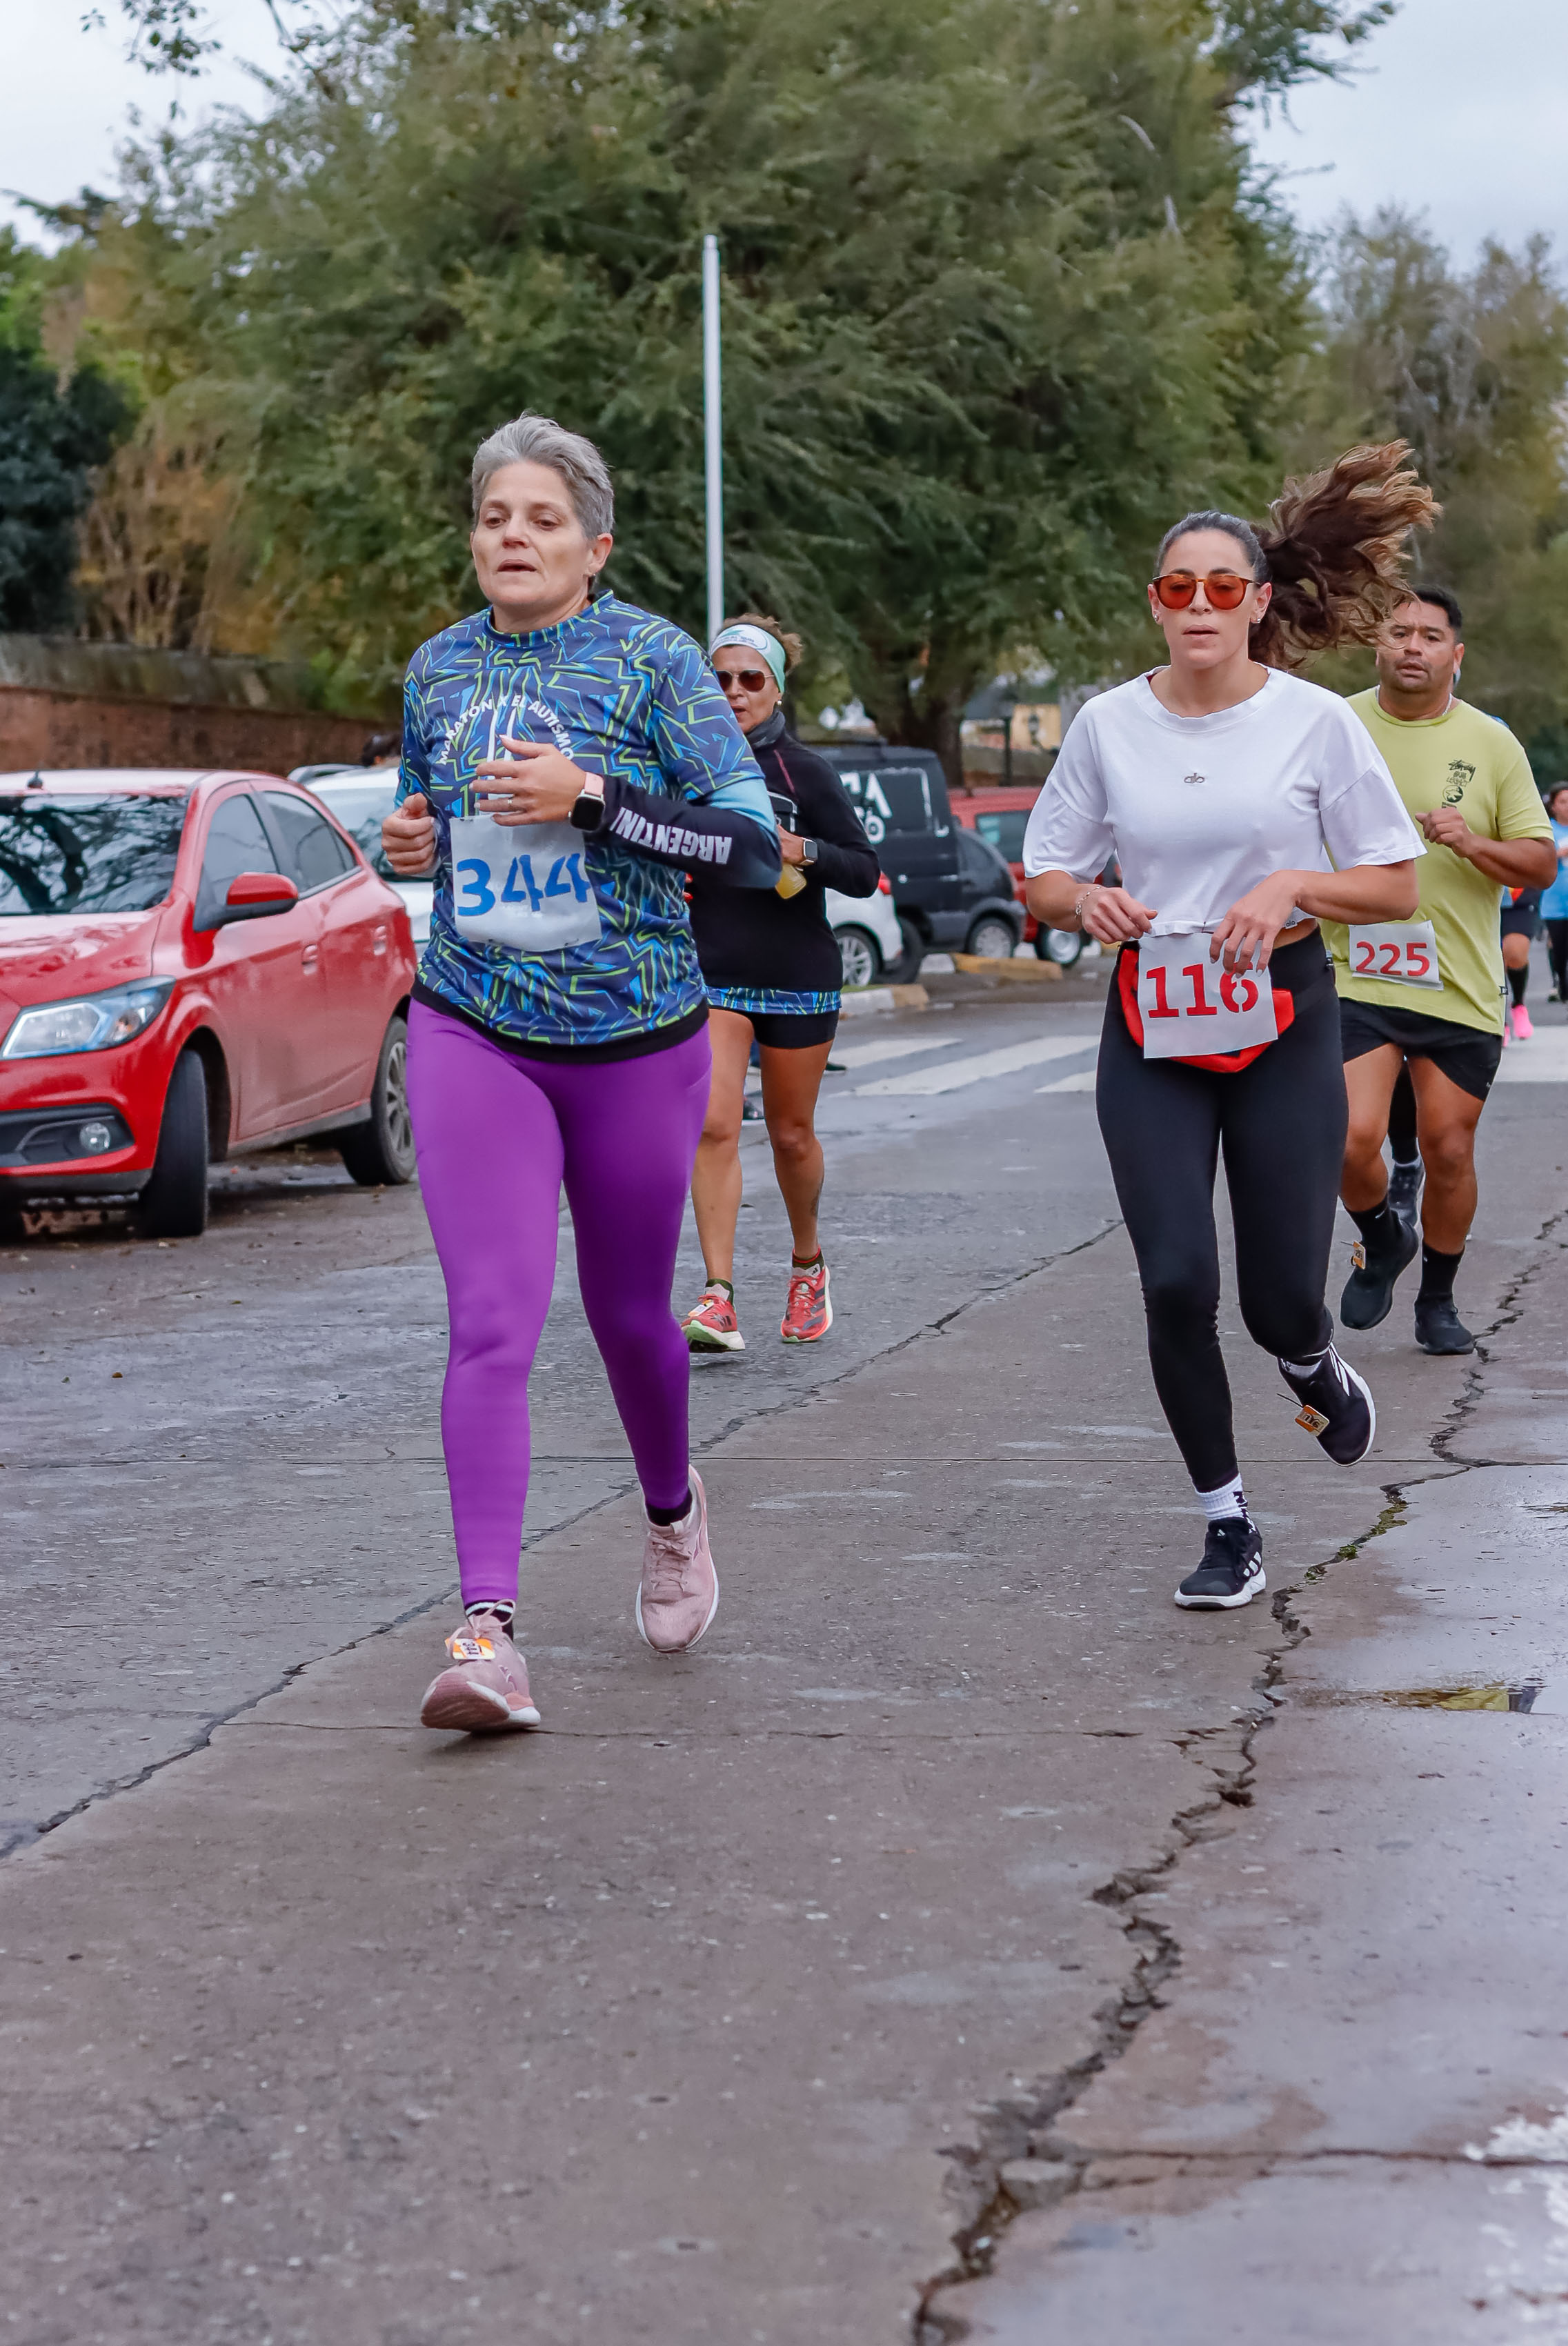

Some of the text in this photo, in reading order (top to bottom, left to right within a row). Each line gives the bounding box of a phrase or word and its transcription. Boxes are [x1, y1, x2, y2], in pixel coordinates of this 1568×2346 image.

[497, 694, 507, 707] X
[511, 695, 526, 708] EL
[528, 700, 575, 760] AUTISMO
[457, 853, 591, 916] 344
[1356, 941, 1430, 976] 225
[1147, 962, 1259, 1018] 116
